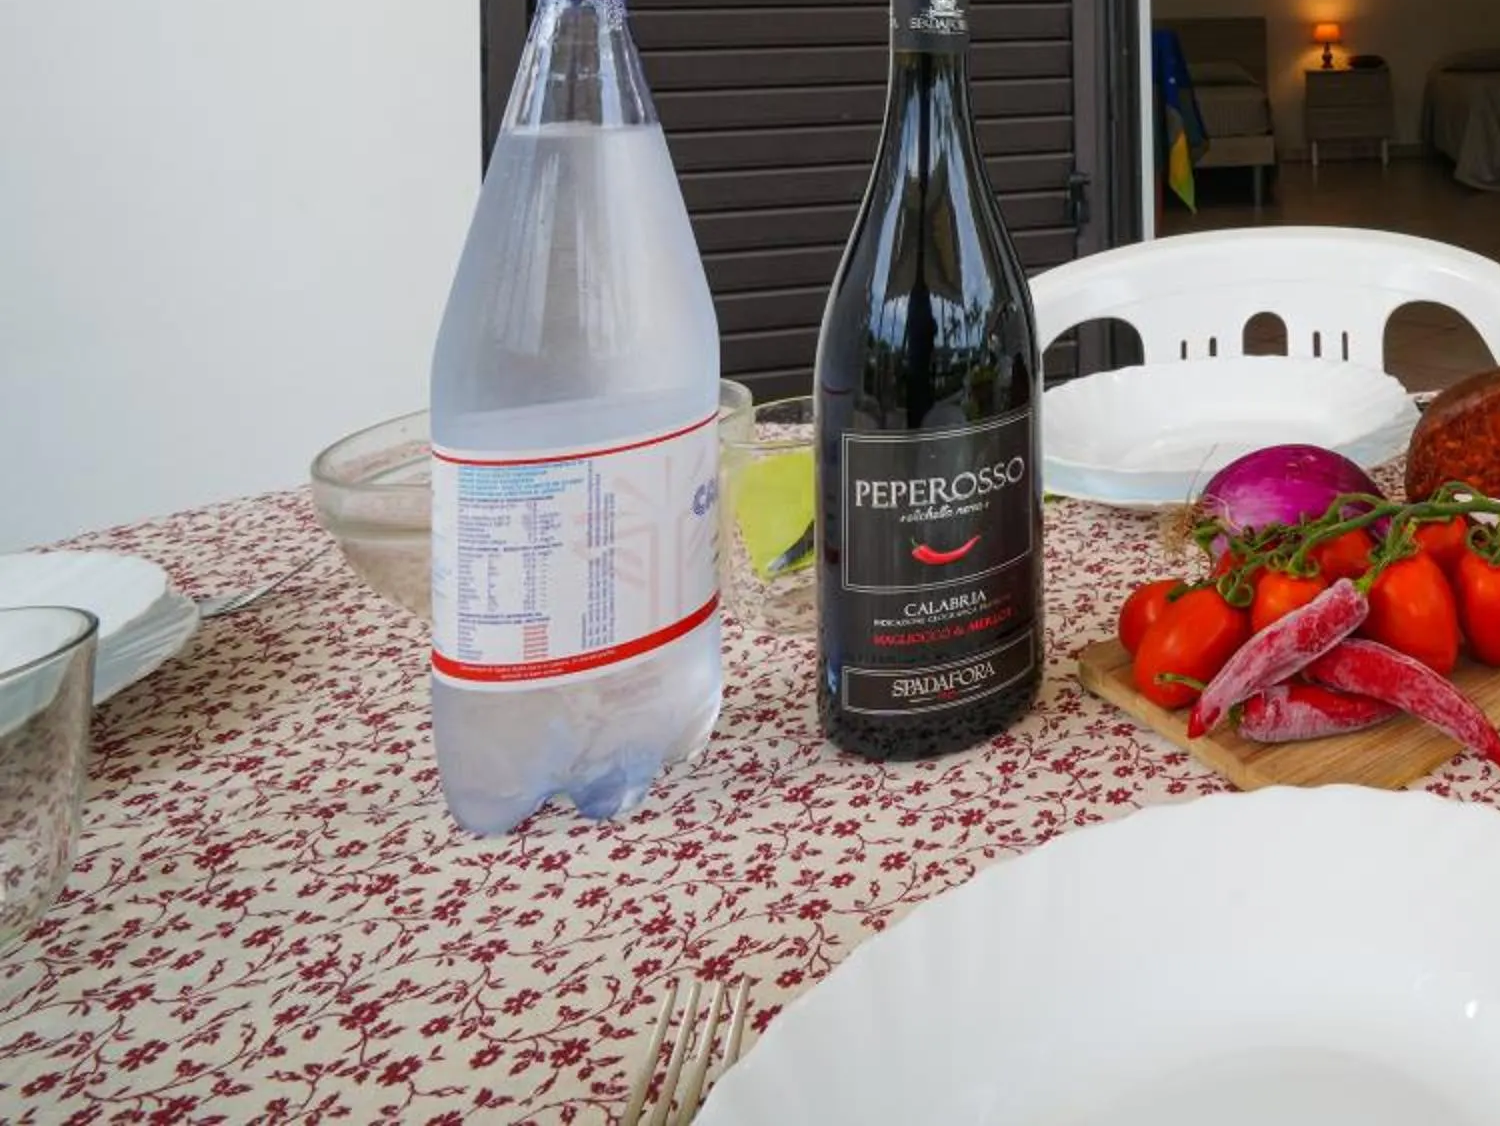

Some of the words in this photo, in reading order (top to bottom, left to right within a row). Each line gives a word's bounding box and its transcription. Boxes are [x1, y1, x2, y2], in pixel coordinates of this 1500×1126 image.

[855, 456, 1025, 509] PEPEROSSO
[903, 589, 987, 617] CALABRIA
[890, 660, 996, 698] SPADAFORA
